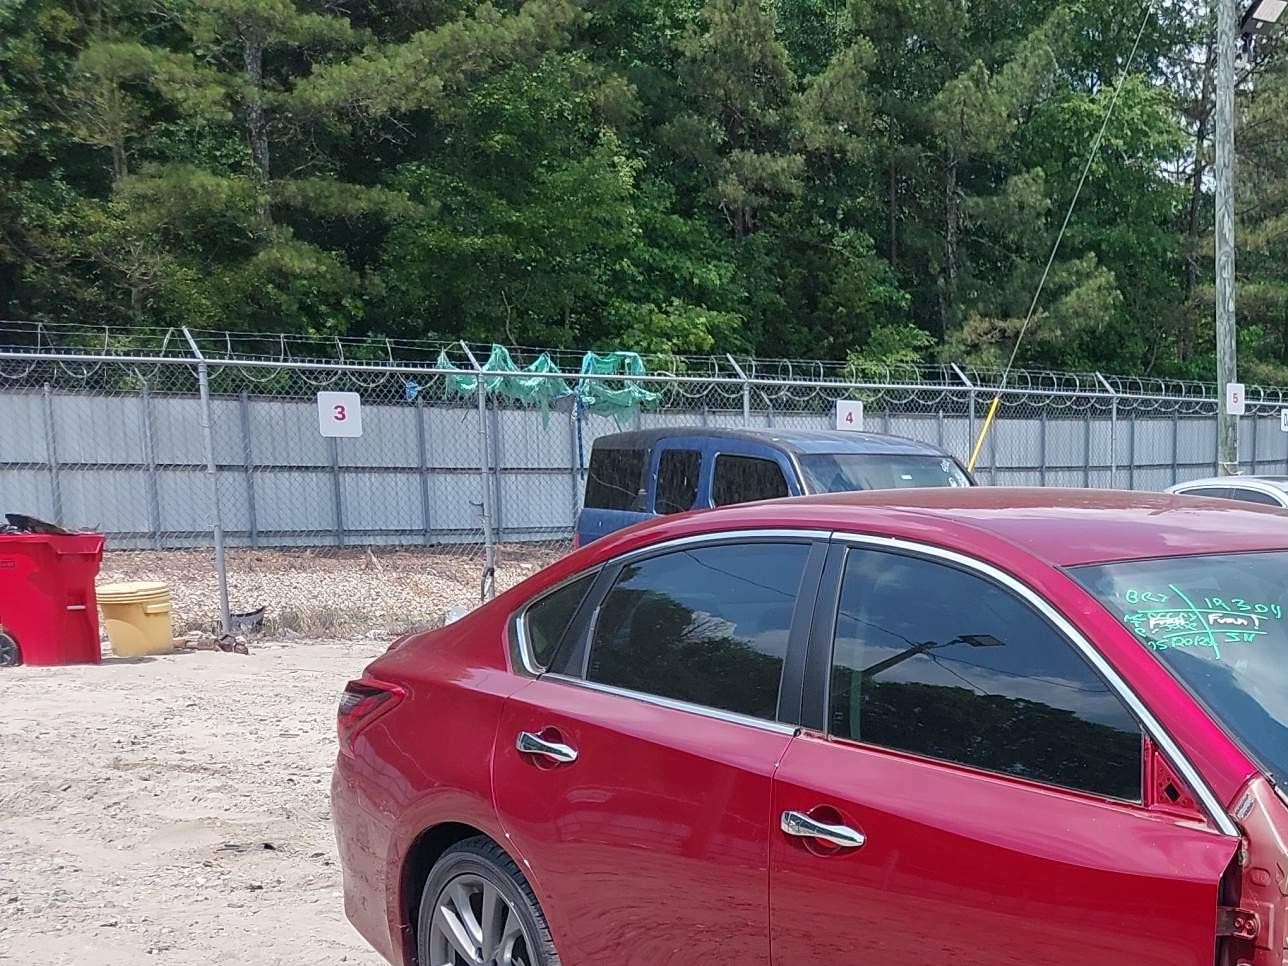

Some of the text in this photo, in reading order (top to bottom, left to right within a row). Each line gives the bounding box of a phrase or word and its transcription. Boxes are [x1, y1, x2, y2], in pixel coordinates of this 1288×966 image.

[1232, 392, 1239, 404] 5
[334, 404, 346, 421] 3
[845, 411, 854, 425] 4
